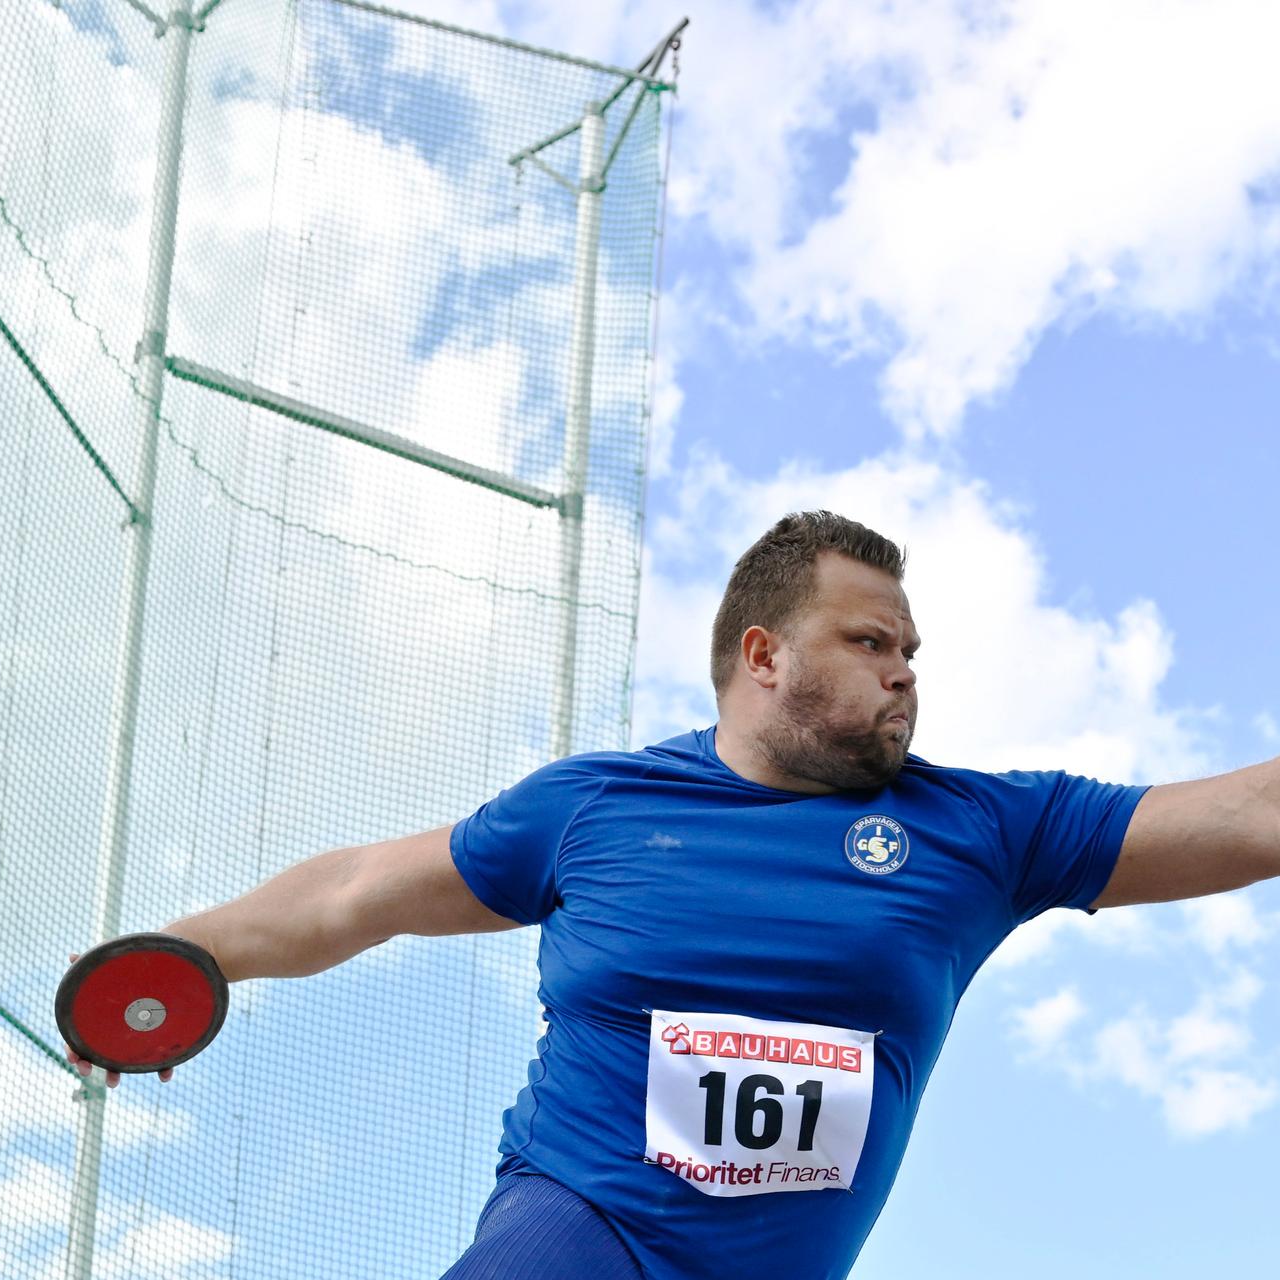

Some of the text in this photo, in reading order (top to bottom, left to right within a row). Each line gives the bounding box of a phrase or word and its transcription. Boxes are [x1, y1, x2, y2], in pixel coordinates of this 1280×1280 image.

[851, 856, 900, 873] STOCKHOLM
[694, 1032, 860, 1071] BAUHAUS
[698, 1070, 824, 1152] 161
[656, 1152, 841, 1186] Prioritet Finans
